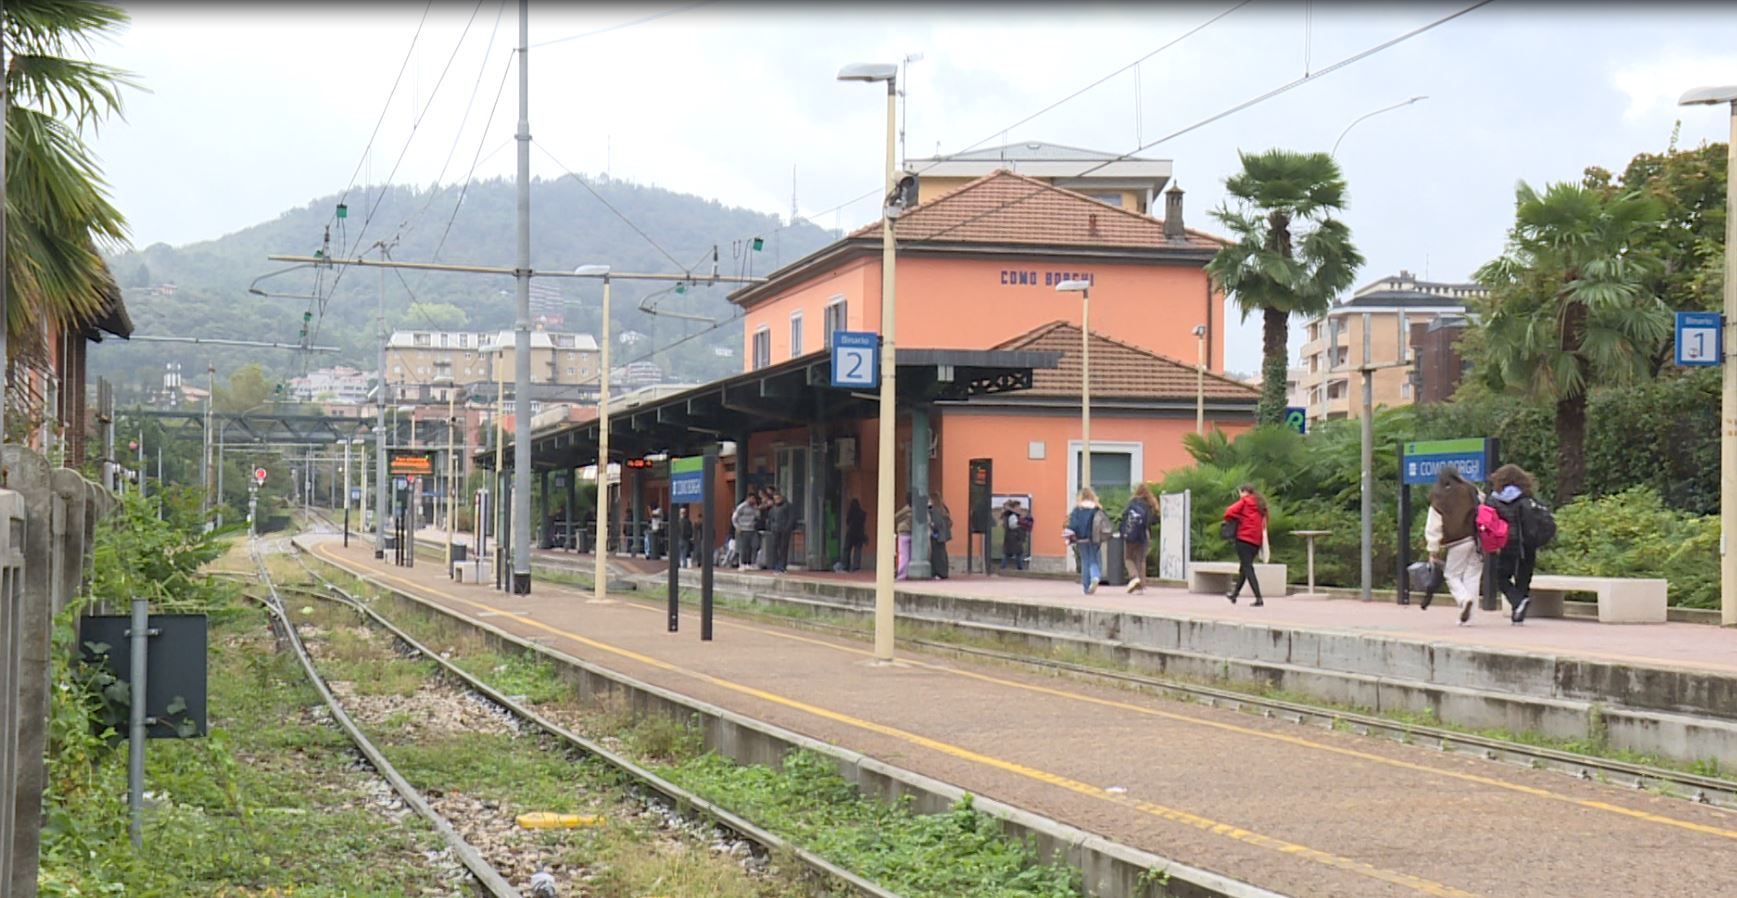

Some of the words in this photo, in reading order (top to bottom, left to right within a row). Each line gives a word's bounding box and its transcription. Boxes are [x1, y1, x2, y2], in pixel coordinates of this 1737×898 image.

[1000, 270, 1036, 285] COMO
[1686, 315, 1713, 325] Binario
[841, 334, 869, 345] Binario
[1694, 332, 1704, 357] 1
[846, 351, 863, 379] 2
